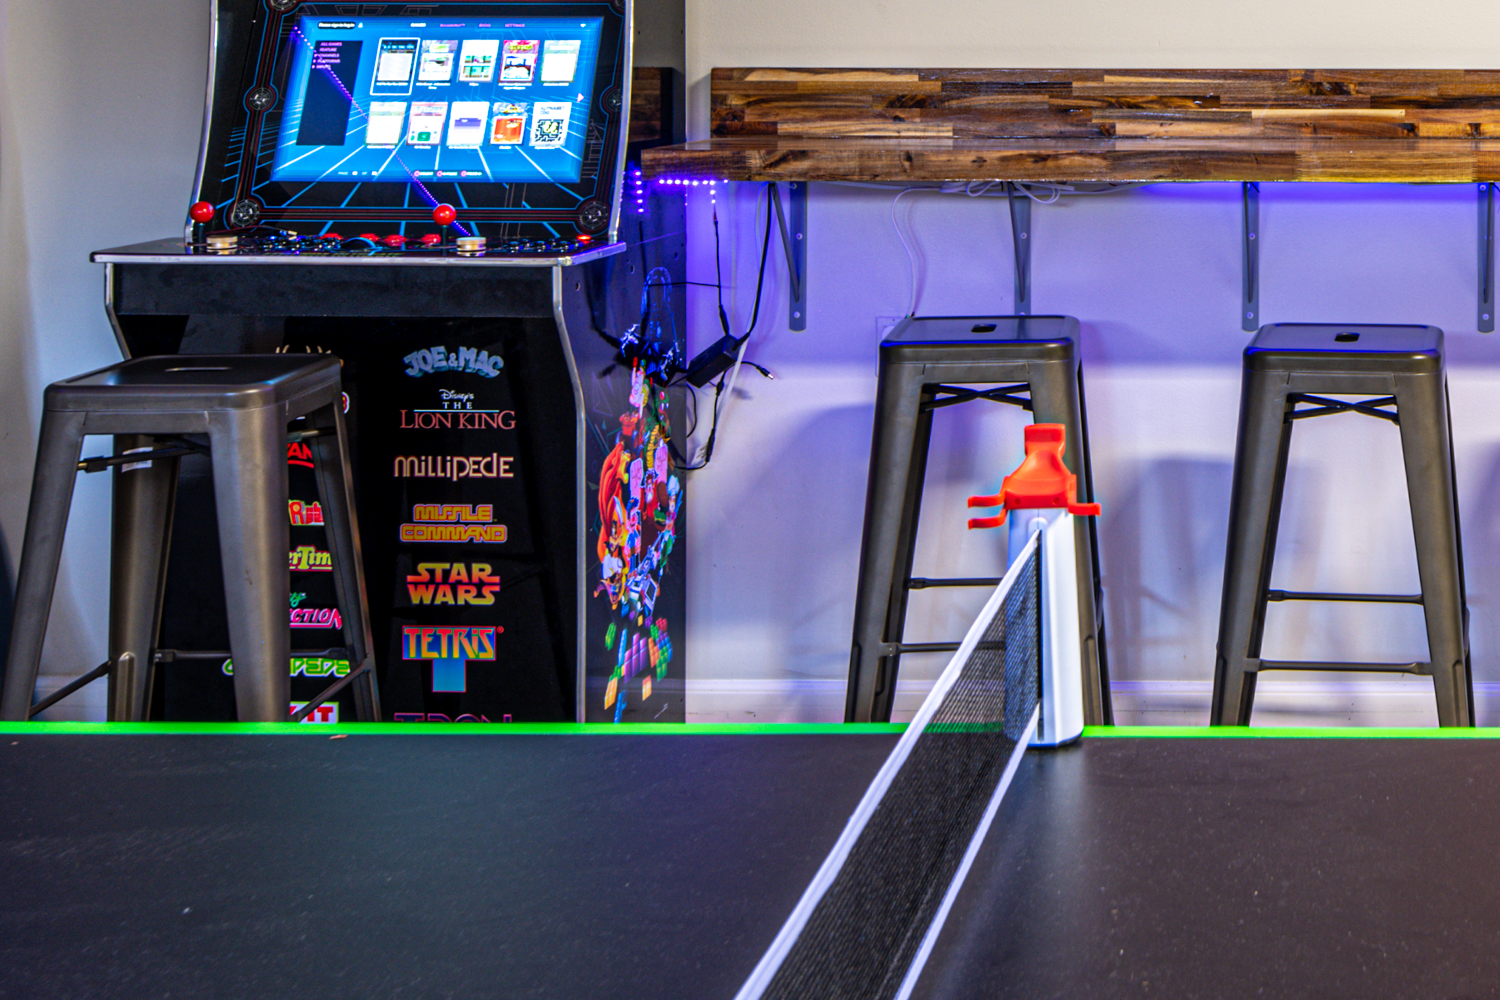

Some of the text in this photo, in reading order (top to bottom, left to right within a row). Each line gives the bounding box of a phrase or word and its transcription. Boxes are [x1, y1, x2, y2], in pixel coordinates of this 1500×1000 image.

[400, 409, 517, 430] LION KING
[414, 504, 492, 522] MISSILE
[400, 524, 507, 543] COMMAND
[406, 563, 500, 583] STAR
[406, 584, 500, 605] WARS
